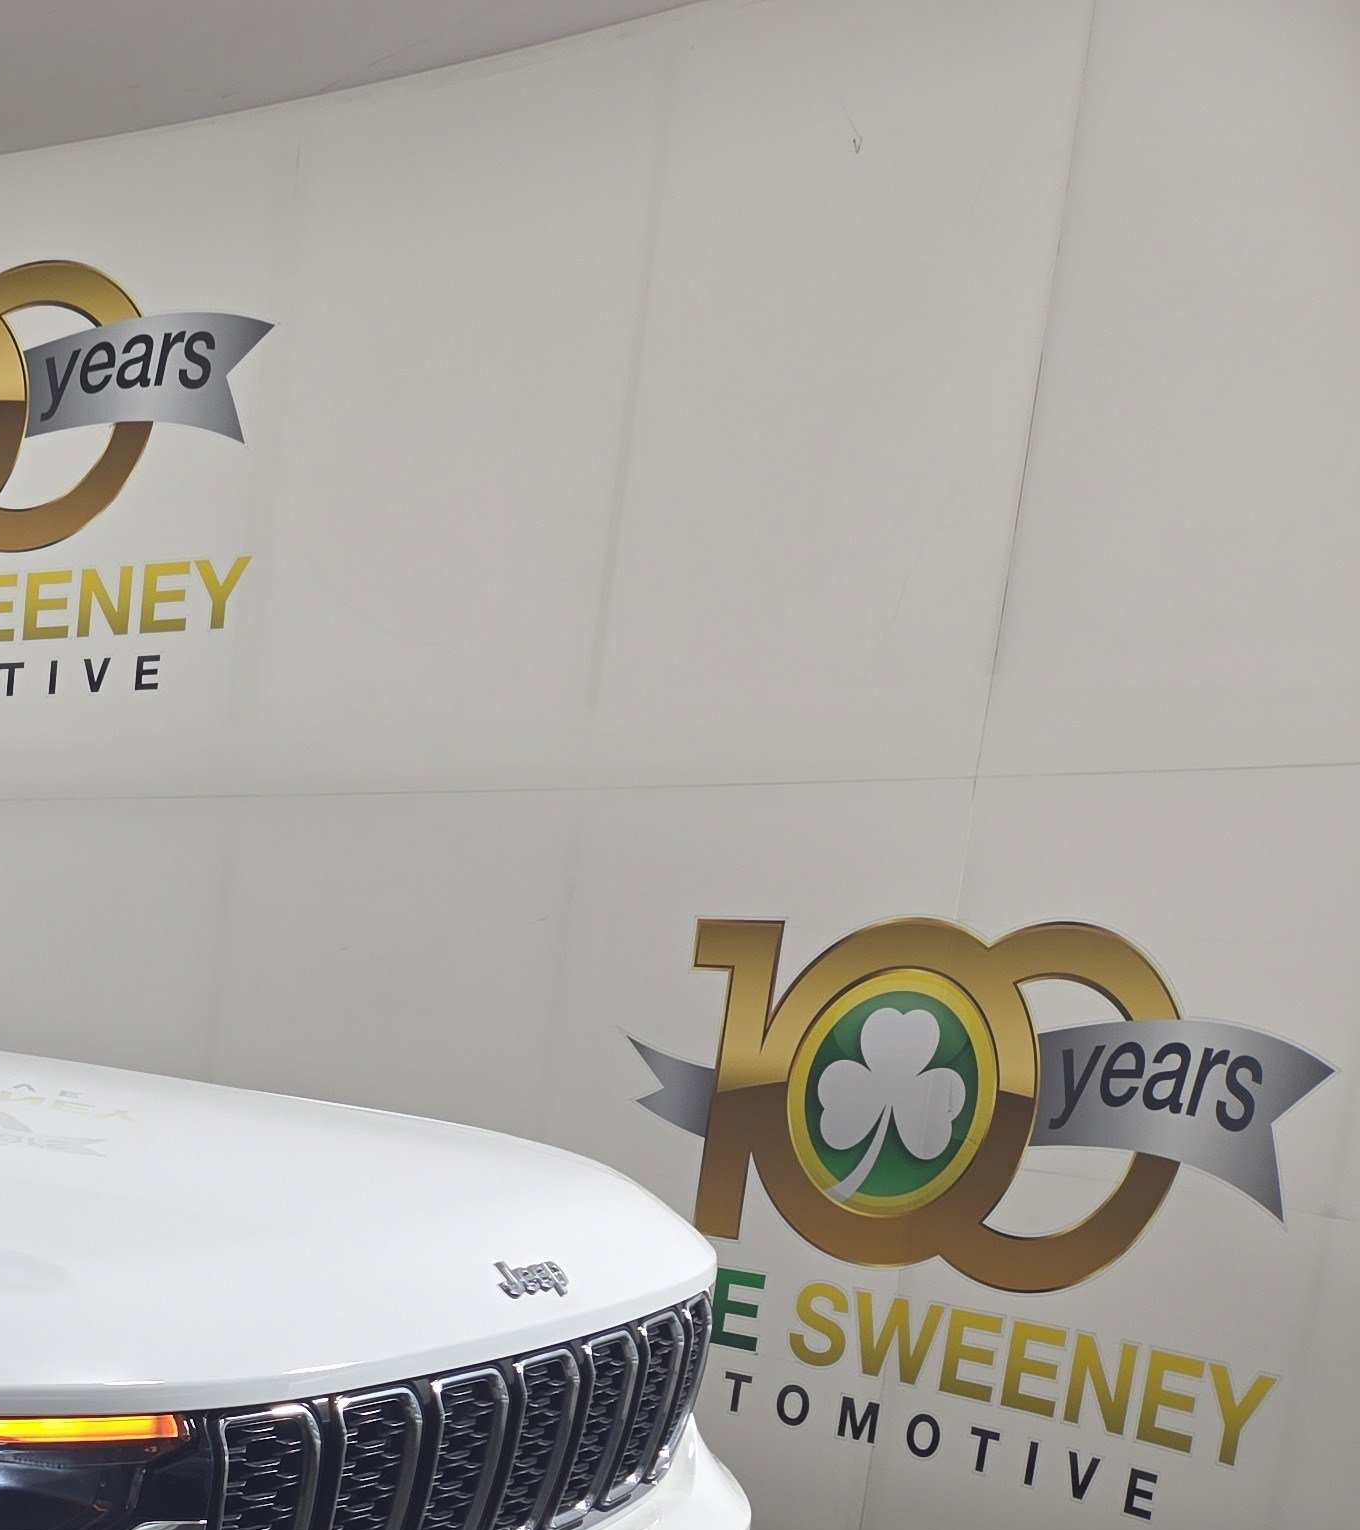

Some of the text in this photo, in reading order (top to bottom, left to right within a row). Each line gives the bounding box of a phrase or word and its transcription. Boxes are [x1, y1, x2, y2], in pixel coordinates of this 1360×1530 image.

[40, 327, 216, 422] years
[692, 917, 1262, 1293] 100 years
[494, 1261, 569, 1299] Jeep
[724, 1372, 1159, 1520] TOMOTIVE
[788, 1283, 1277, 1466] SWEENEY
